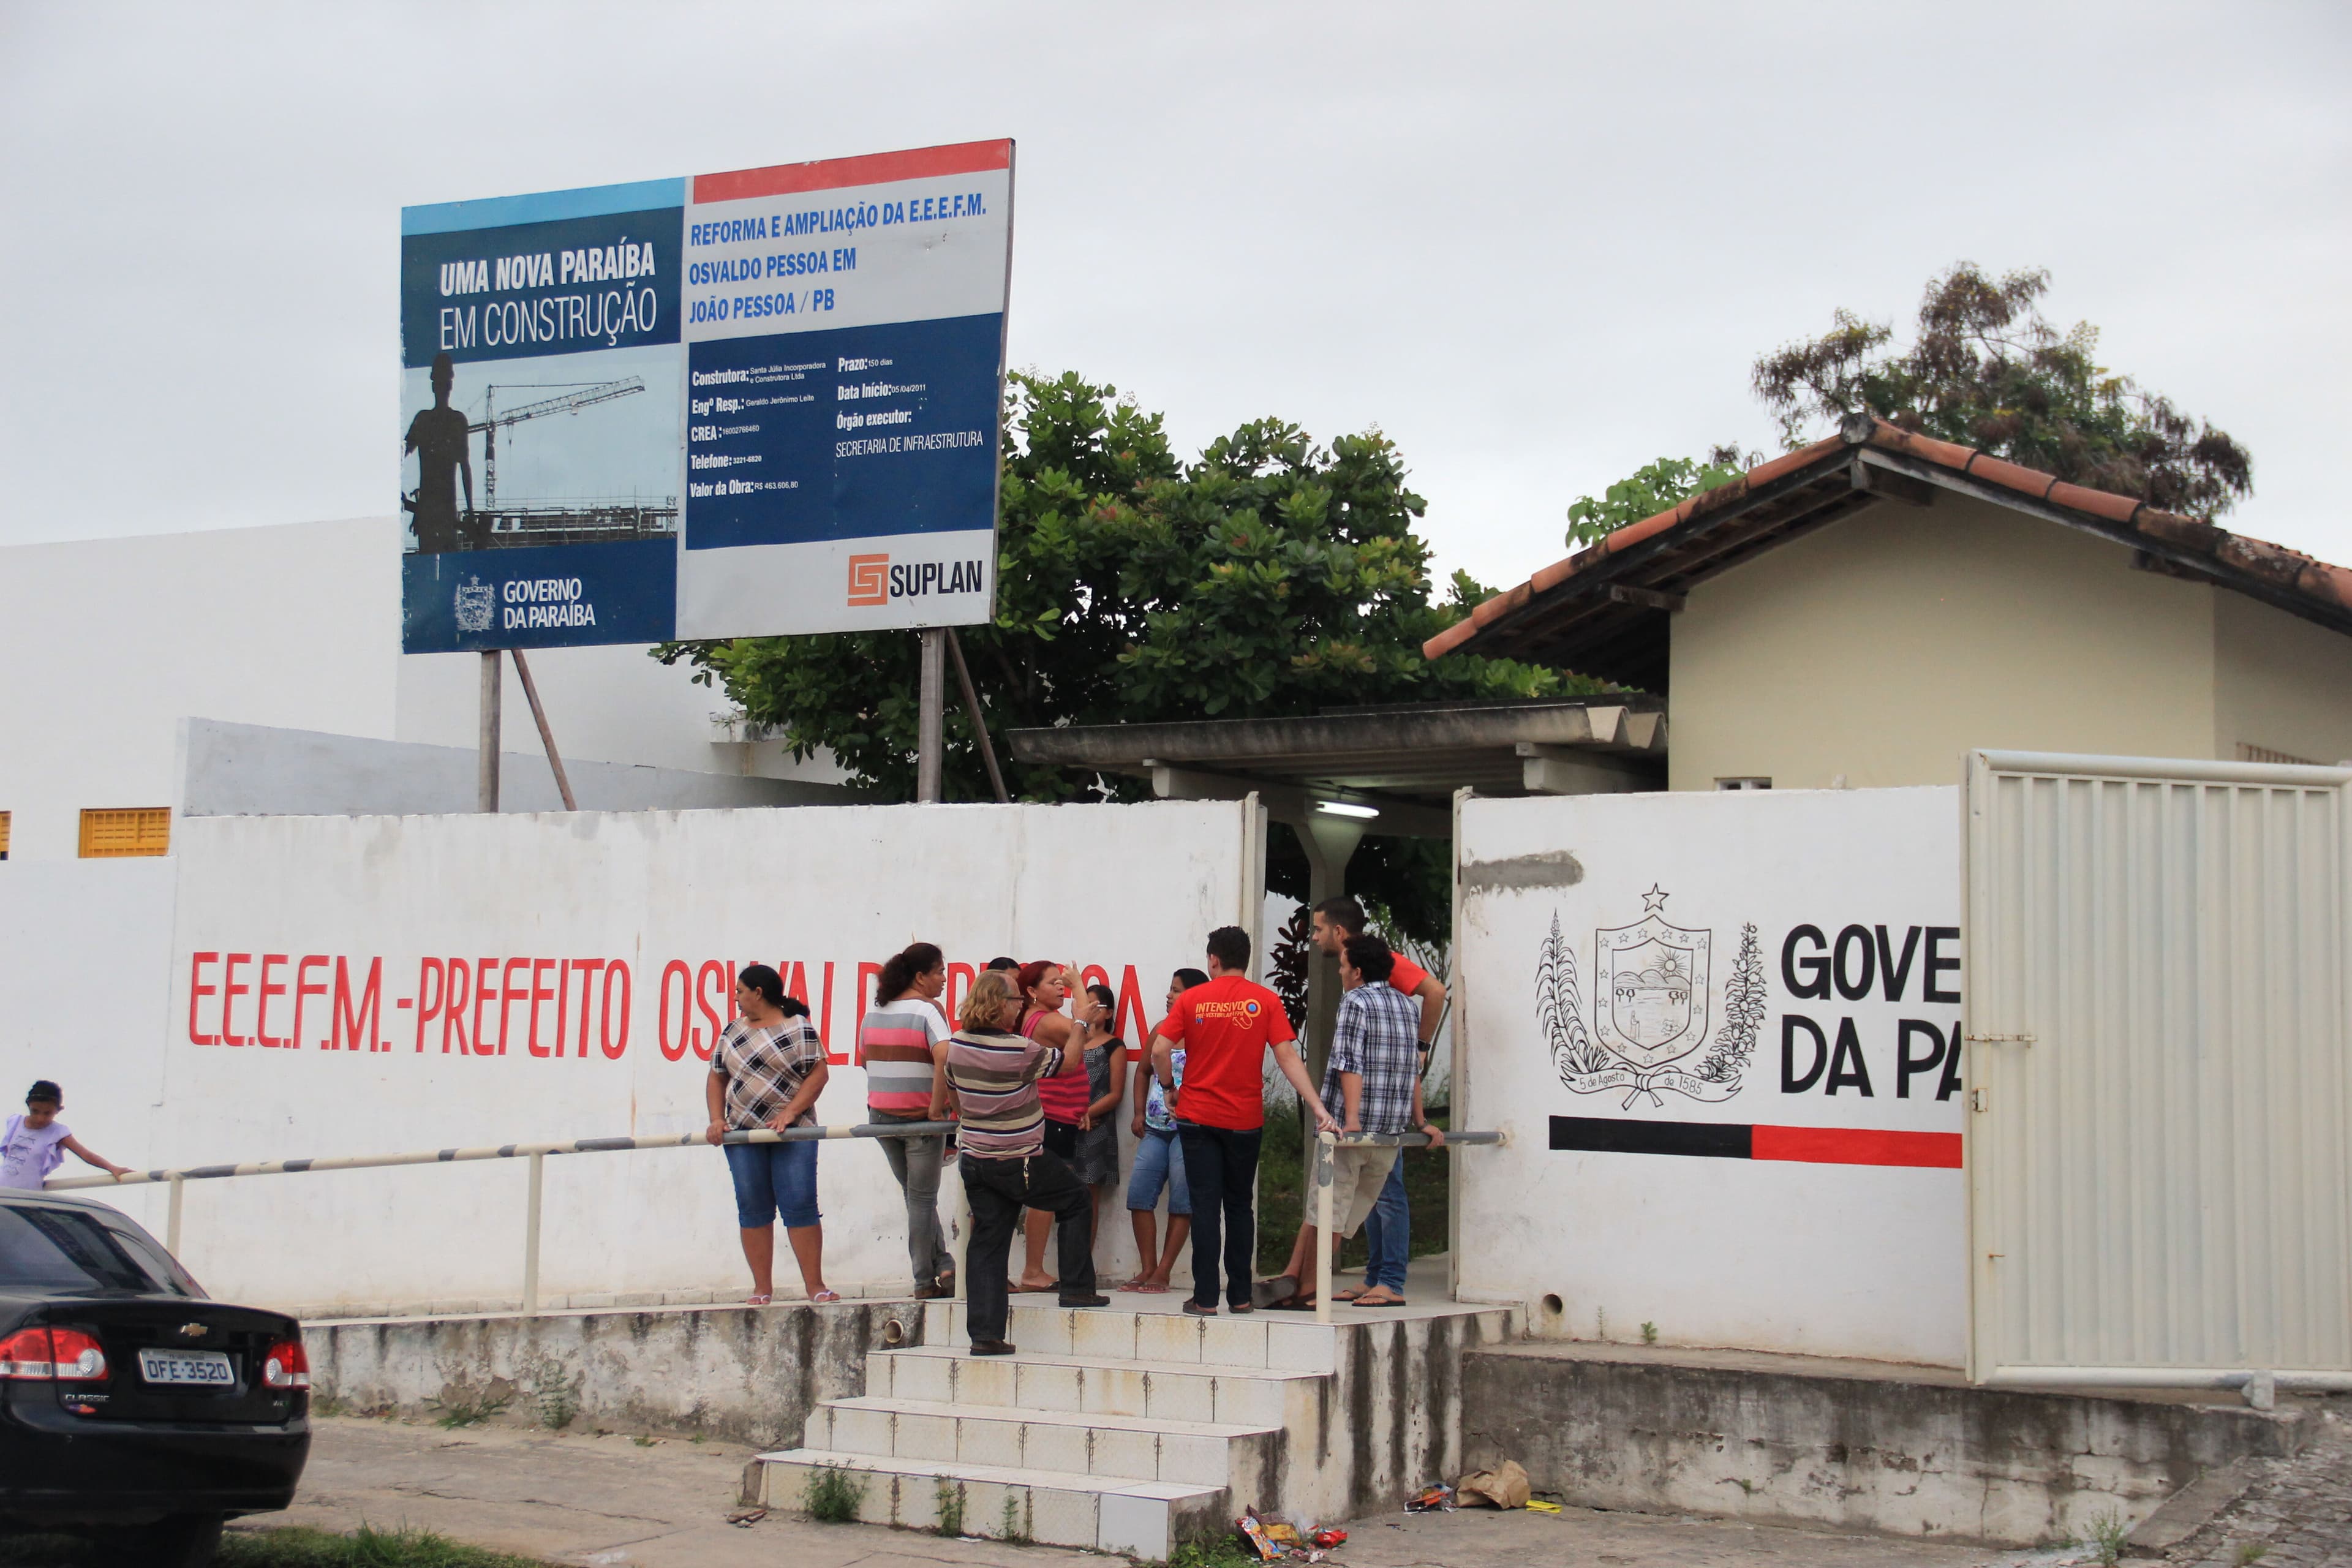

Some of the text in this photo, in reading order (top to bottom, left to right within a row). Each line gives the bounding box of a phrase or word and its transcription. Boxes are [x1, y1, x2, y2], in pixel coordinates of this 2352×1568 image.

[691, 193, 986, 246] REFORMA E AMPLIAÇÃO DA E.E.E.F.M.
[440, 236, 656, 297] UMA NOVA PARAÍBA
[689, 247, 856, 285] OSVALDO PESSOA EM
[440, 281, 657, 350] EM CONSTRUÇÃO
[690, 288, 835, 323] JOÃO PESSOA / PB
[692, 369, 749, 386] Construtora:
[784, 362, 826, 372] Incorporadora
[838, 357, 868, 372] Prazo:
[755, 375, 790, 383] Construtora
[837, 385, 859, 401] Data
[862, 381, 892, 399] Início:
[715, 397, 744, 414] Resp.:
[745, 398, 769, 407] Geraldo
[769, 395, 799, 405] Jerônimo
[799, 394, 815, 402] Leite
[836, 409, 912, 432] Órgão executor:
[836, 431, 984, 458] SECRETARIA DE INFRAESTRUTURA
[690, 453, 733, 470] Telefone:
[690, 483, 713, 498] Valor
[715, 480, 726, 496] da
[729, 479, 754, 495] Obra:
[503, 578, 582, 603] GOVERNO
[890, 560, 982, 598] SUPLAN
[504, 600, 597, 629] DA PARAÍBA
[415, 956, 631, 1060] PREFEITO
[1196, 1001, 1244, 1013] INTENSIVO
[1781, 1014, 1874, 1097] DA
[1580, 1072, 1704, 1095] 5 de Agosto de 1585
